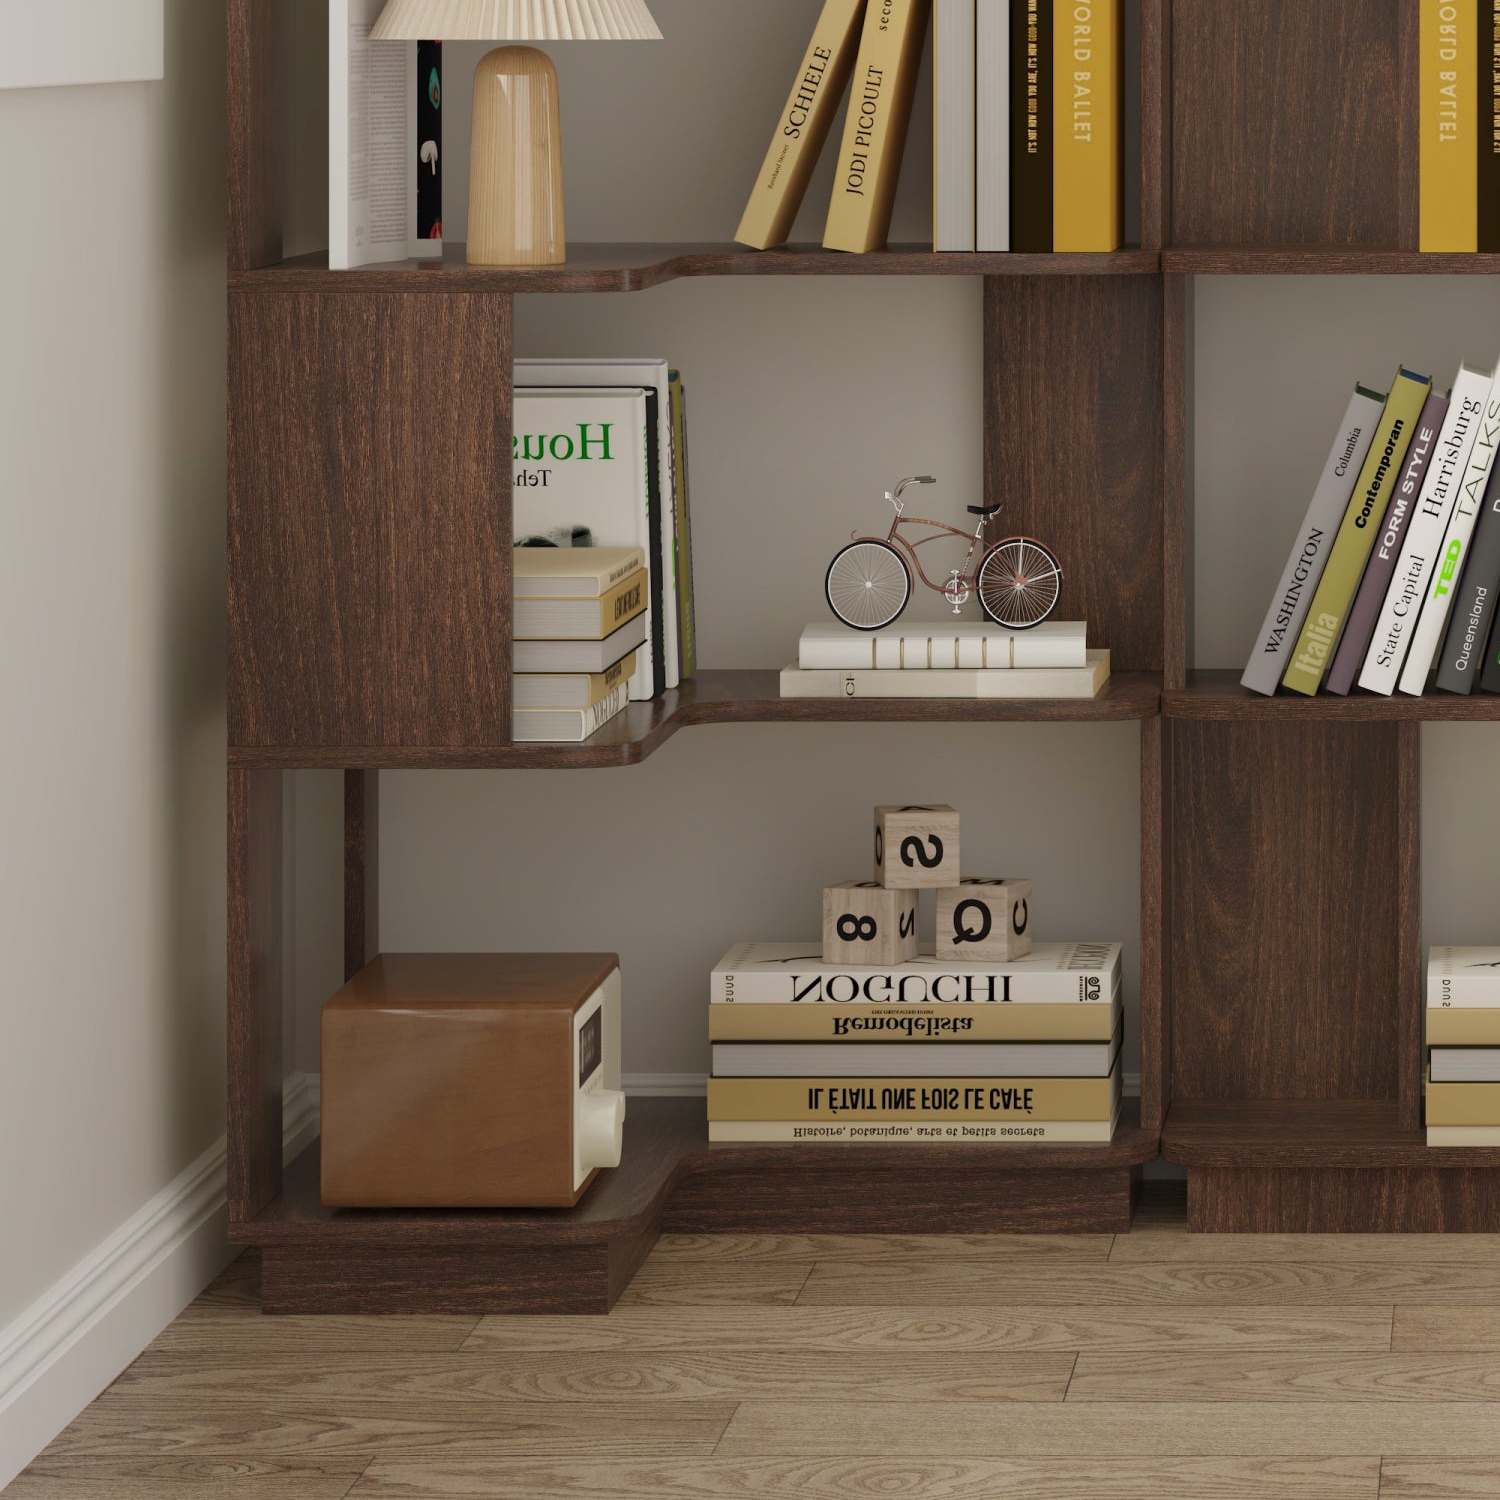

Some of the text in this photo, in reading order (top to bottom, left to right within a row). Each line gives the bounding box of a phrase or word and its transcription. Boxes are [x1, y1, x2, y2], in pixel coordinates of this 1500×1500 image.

[783, 46, 832, 139] SCHIELE
[846, 64, 883, 196] JODI PICOULT
[1072, 71, 1092, 143] BALLET
[1265, 427, 1361, 654] WASHINGTON Columbia
[1294, 418, 1405, 676] Italia Contemporan
[1376, 396, 1481, 668] State Capital Harrisburg
[1378, 427, 1434, 560] FORM STYLE
[1433, 539, 1461, 600] TED
[1455, 586, 1487, 672] Queensland
